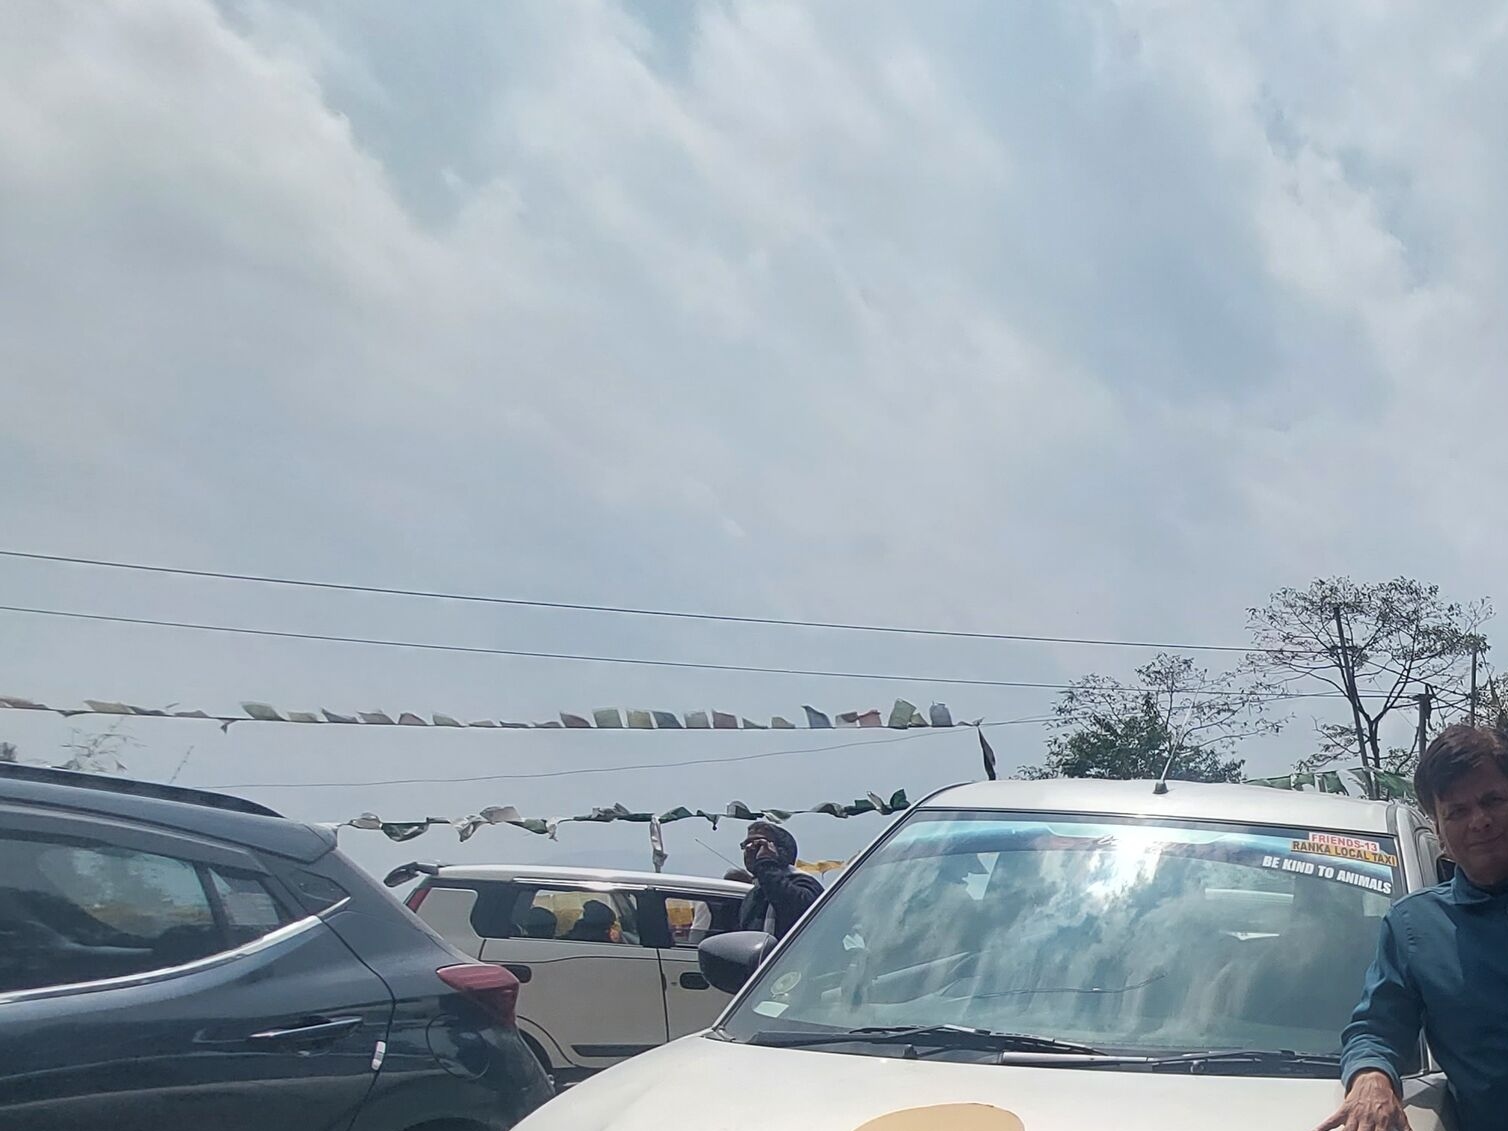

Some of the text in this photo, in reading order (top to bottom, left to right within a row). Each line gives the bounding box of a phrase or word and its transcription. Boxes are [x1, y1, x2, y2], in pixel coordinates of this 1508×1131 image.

[1292, 840, 1396, 866] RANKA LOCAL TAXI
[1311, 833, 1378, 852] FRIENDS-13
[1262, 856, 1392, 894] BE KIND TO ANIMALS
